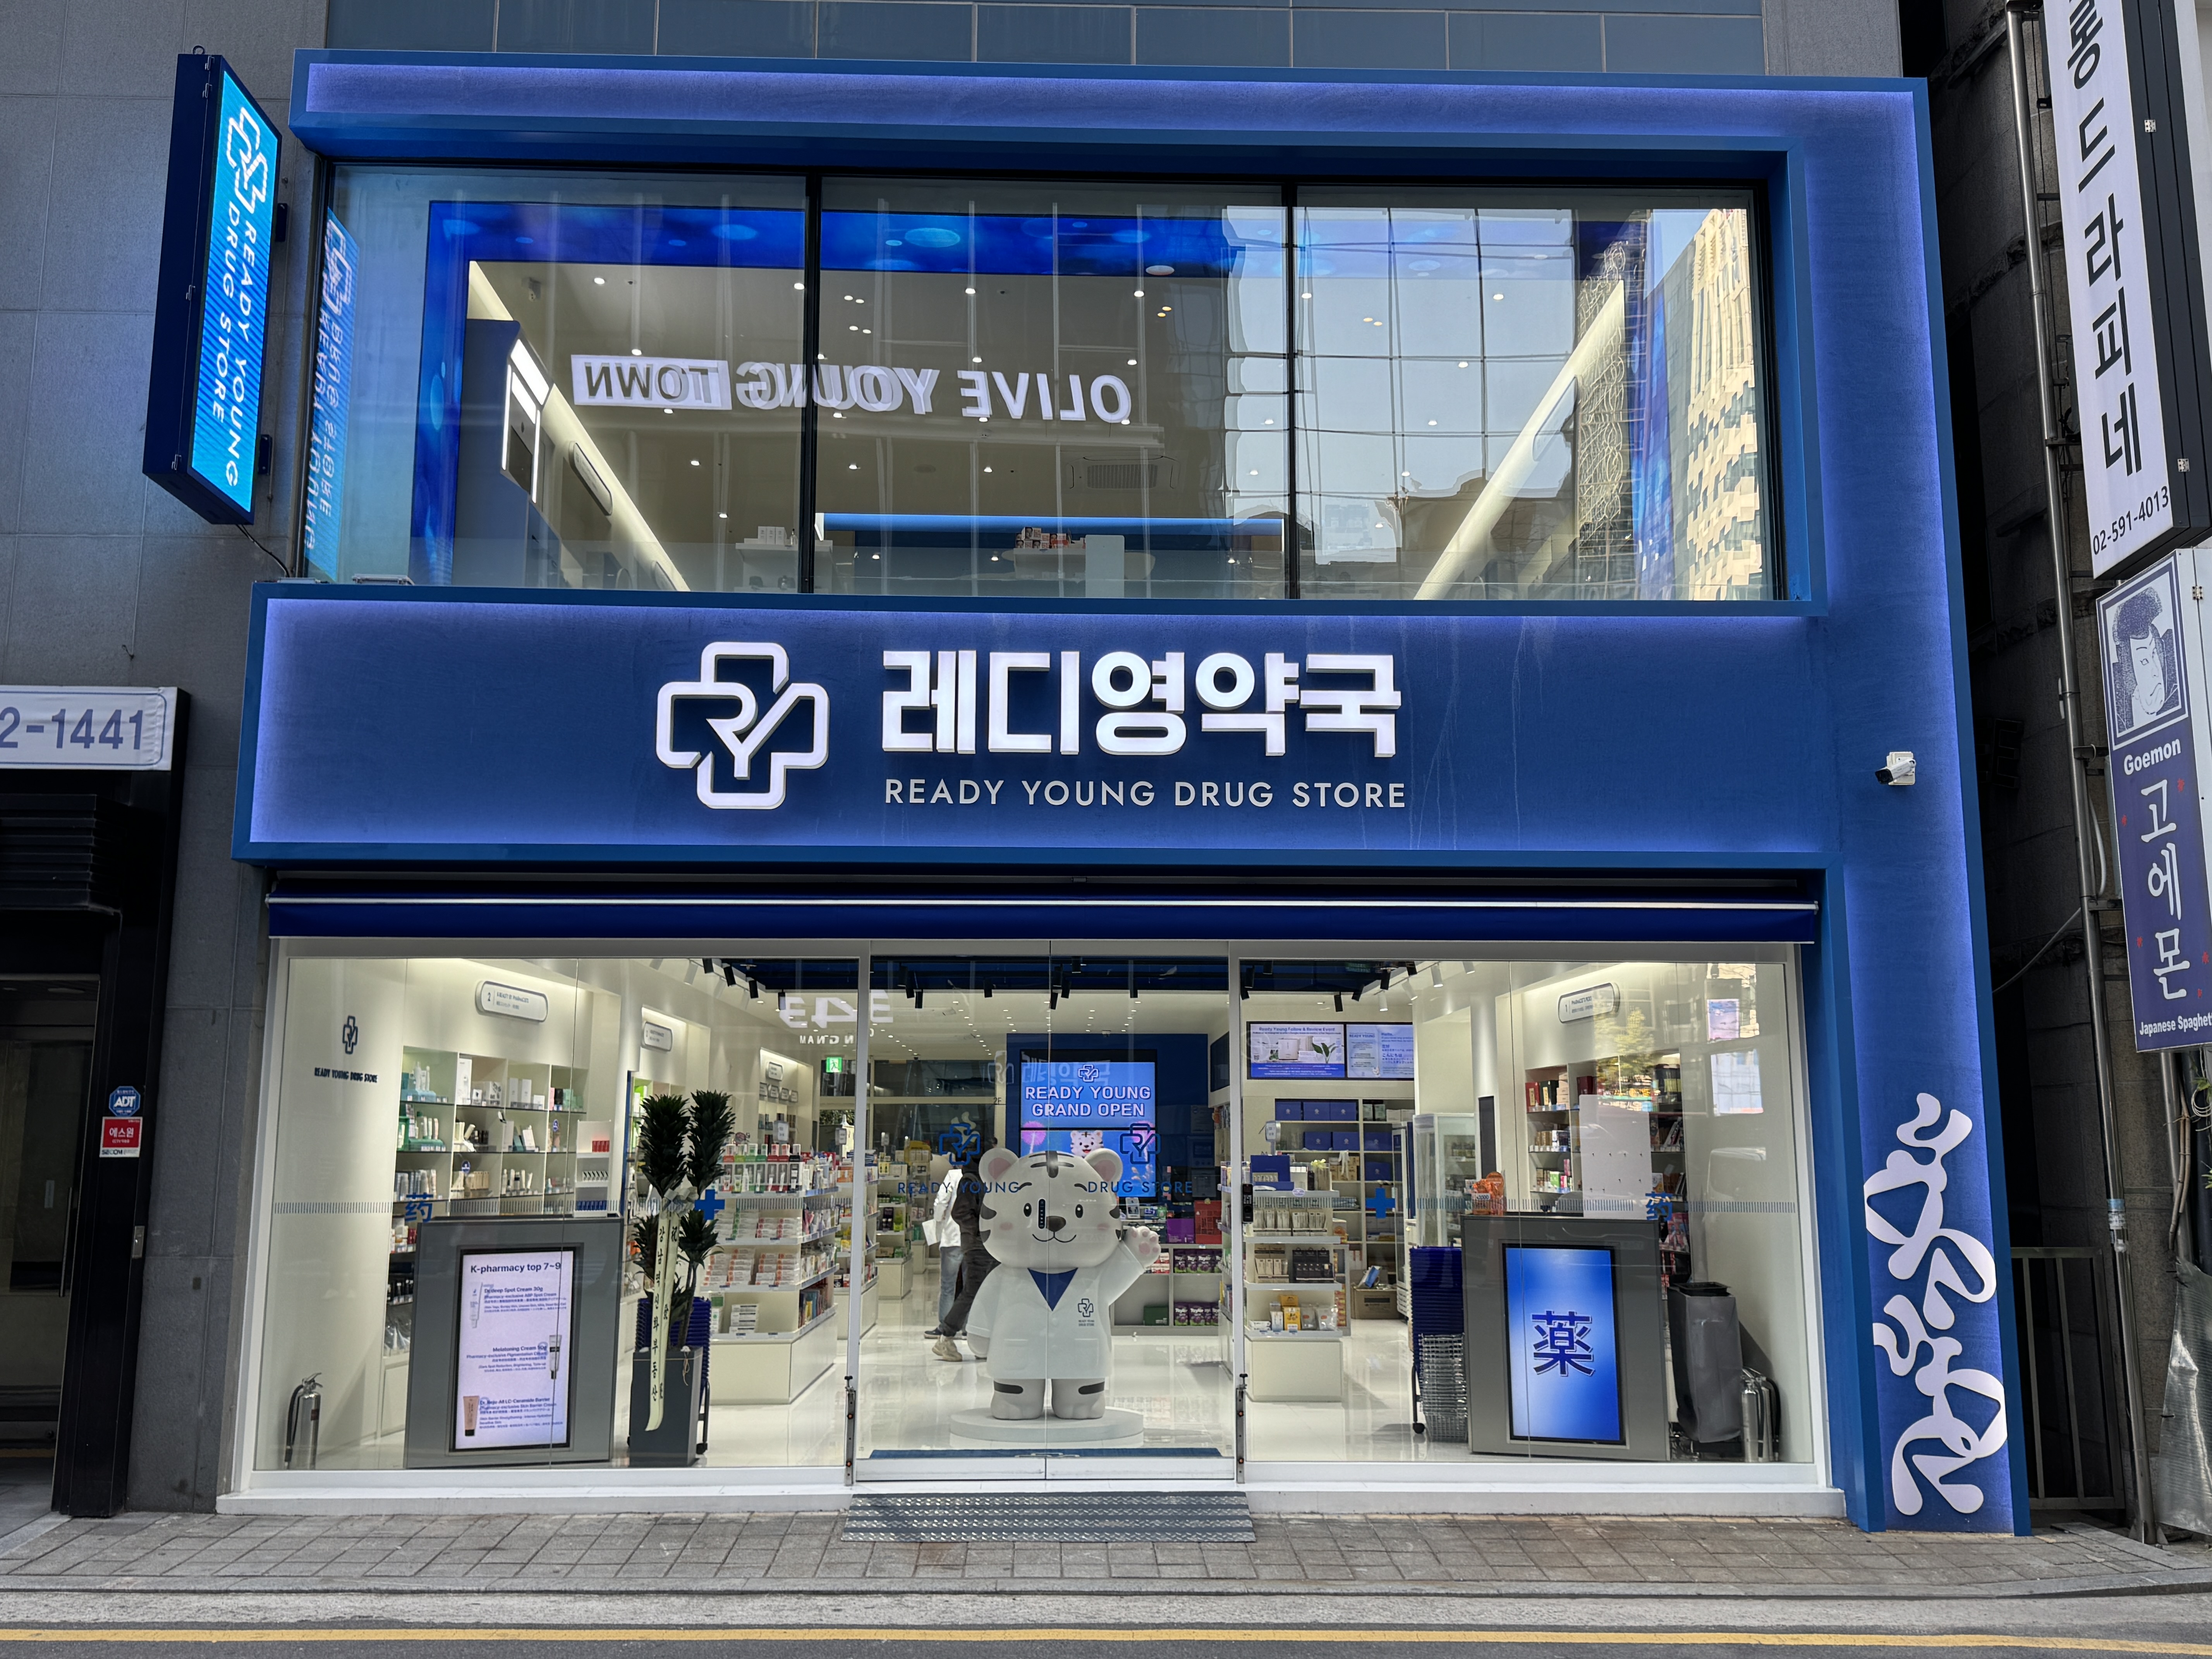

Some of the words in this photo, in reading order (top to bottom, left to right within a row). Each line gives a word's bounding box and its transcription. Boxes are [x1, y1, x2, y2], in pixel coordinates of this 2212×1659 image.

[223, 200, 240, 299] DRUG
[238, 220, 257, 342] READY
[213, 311, 232, 424] STORE
[226, 356, 247, 487] YOUNG
[2092, 485, 2169, 555] 02-591-4013
[882, 650, 1402, 757] 레디영약국
[0, 706, 144, 750] 2-1441
[2123, 738, 2181, 776] Goemon
[885, 778, 1004, 805] READY
[1021, 780, 1155, 806] YOUNG
[1175, 781, 1273, 807] DRUG
[1292, 782, 1405, 808] STORE
[2140, 778, 2190, 1000] 고에몬
[2139, 1020, 2176, 1037] Japanese
[2177, 1012, 2212, 1032] Spaghet
[314, 1067, 331, 1078] READY
[332, 1069, 349, 1081] YOUNG
[114, 1096, 136, 1108] ADT
[1025, 1086, 1083, 1099] READY
[1090, 1086, 1151, 1100] YOUNG
[1032, 1103, 1092, 1117] GRAND
[1097, 1103, 1145, 1116] OPEN
[109, 1127, 134, 1138] 에스원
[898, 1182, 951, 1194] READY
[960, 1181, 1020, 1194] YOUNG
[1087, 1181, 1133, 1194] DRUG
[1142, 1181, 1193, 1194] STORE
[405, 1192, 434, 1223] 药
[471, 1264, 525, 1274] K-pharmacy
[527, 1264, 541, 1272] top
[1532, 1310, 1595, 1377] 薬
